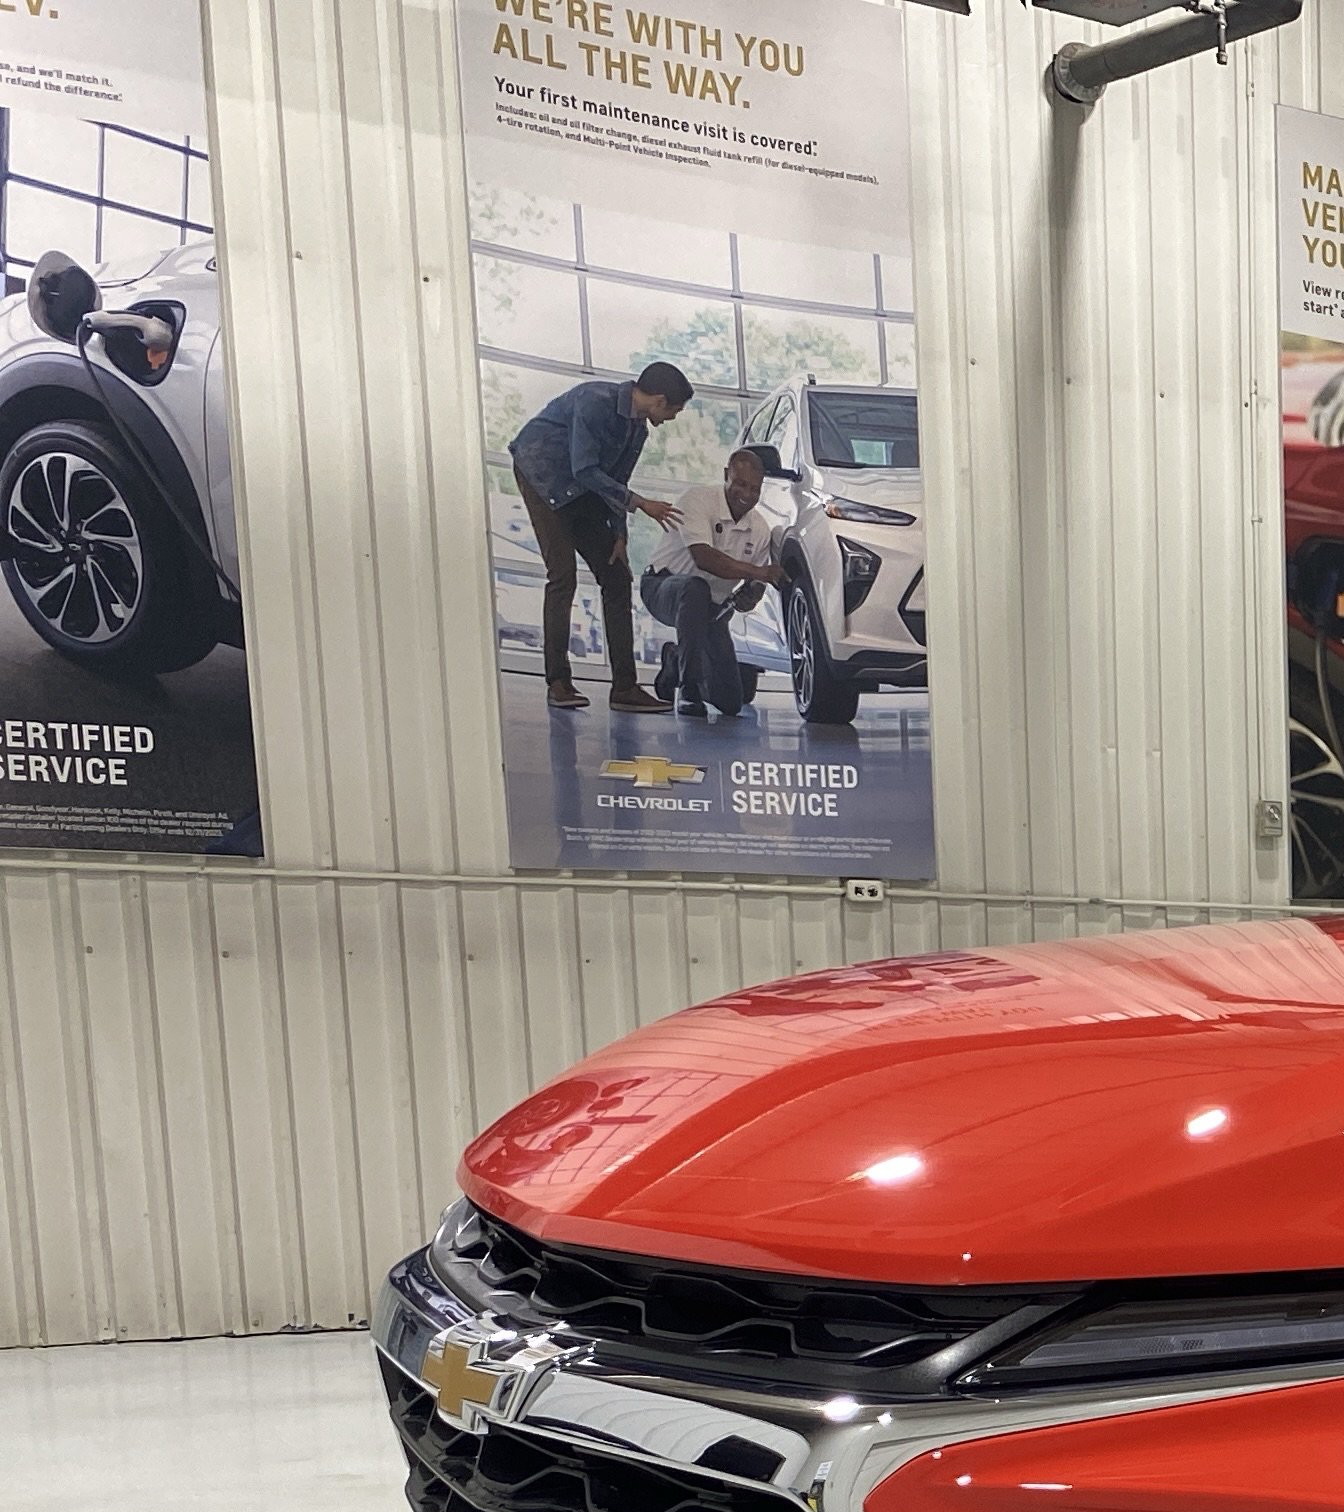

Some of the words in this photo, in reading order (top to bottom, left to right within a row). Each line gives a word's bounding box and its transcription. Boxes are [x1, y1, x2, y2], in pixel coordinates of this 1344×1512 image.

[626, 9, 723, 61] WITH
[735, 33, 804, 76] YOU
[16, 65, 36, 74] and
[65, 72, 99, 84] match
[493, 23, 567, 70] ALL
[578, 41, 652, 89] THE
[663, 60, 750, 108] WAY.
[5, 76, 41, 89] refund
[44, 81, 61, 92] the
[494, 76, 534, 100] Your
[540, 87, 577, 111] first
[583, 98, 689, 134] maintenance
[693, 121, 728, 141] visit
[733, 127, 746, 143] is
[539, 112, 550, 123] oil
[551, 116, 568, 126] and
[569, 119, 581, 129] oil
[583, 121, 604, 134] filter
[641, 134, 667, 147] diesel
[668, 140, 701, 153] exhaust
[702, 146, 722, 158] fluid
[723, 150, 741, 162] tank
[744, 155, 763, 166] refill
[565, 131, 582, 142] and
[583, 135, 632, 153] Multi-Point
[633, 144, 663, 159] Vehicle
[1302, 279, 1332, 297] View
[0, 719, 155, 754] ERTIFIED
[0, 753, 128, 786] ERVICE
[730, 760, 858, 789] CERTIFIED
[597, 794, 712, 812] CHEVROLET
[732, 790, 839, 817] SERVICE
